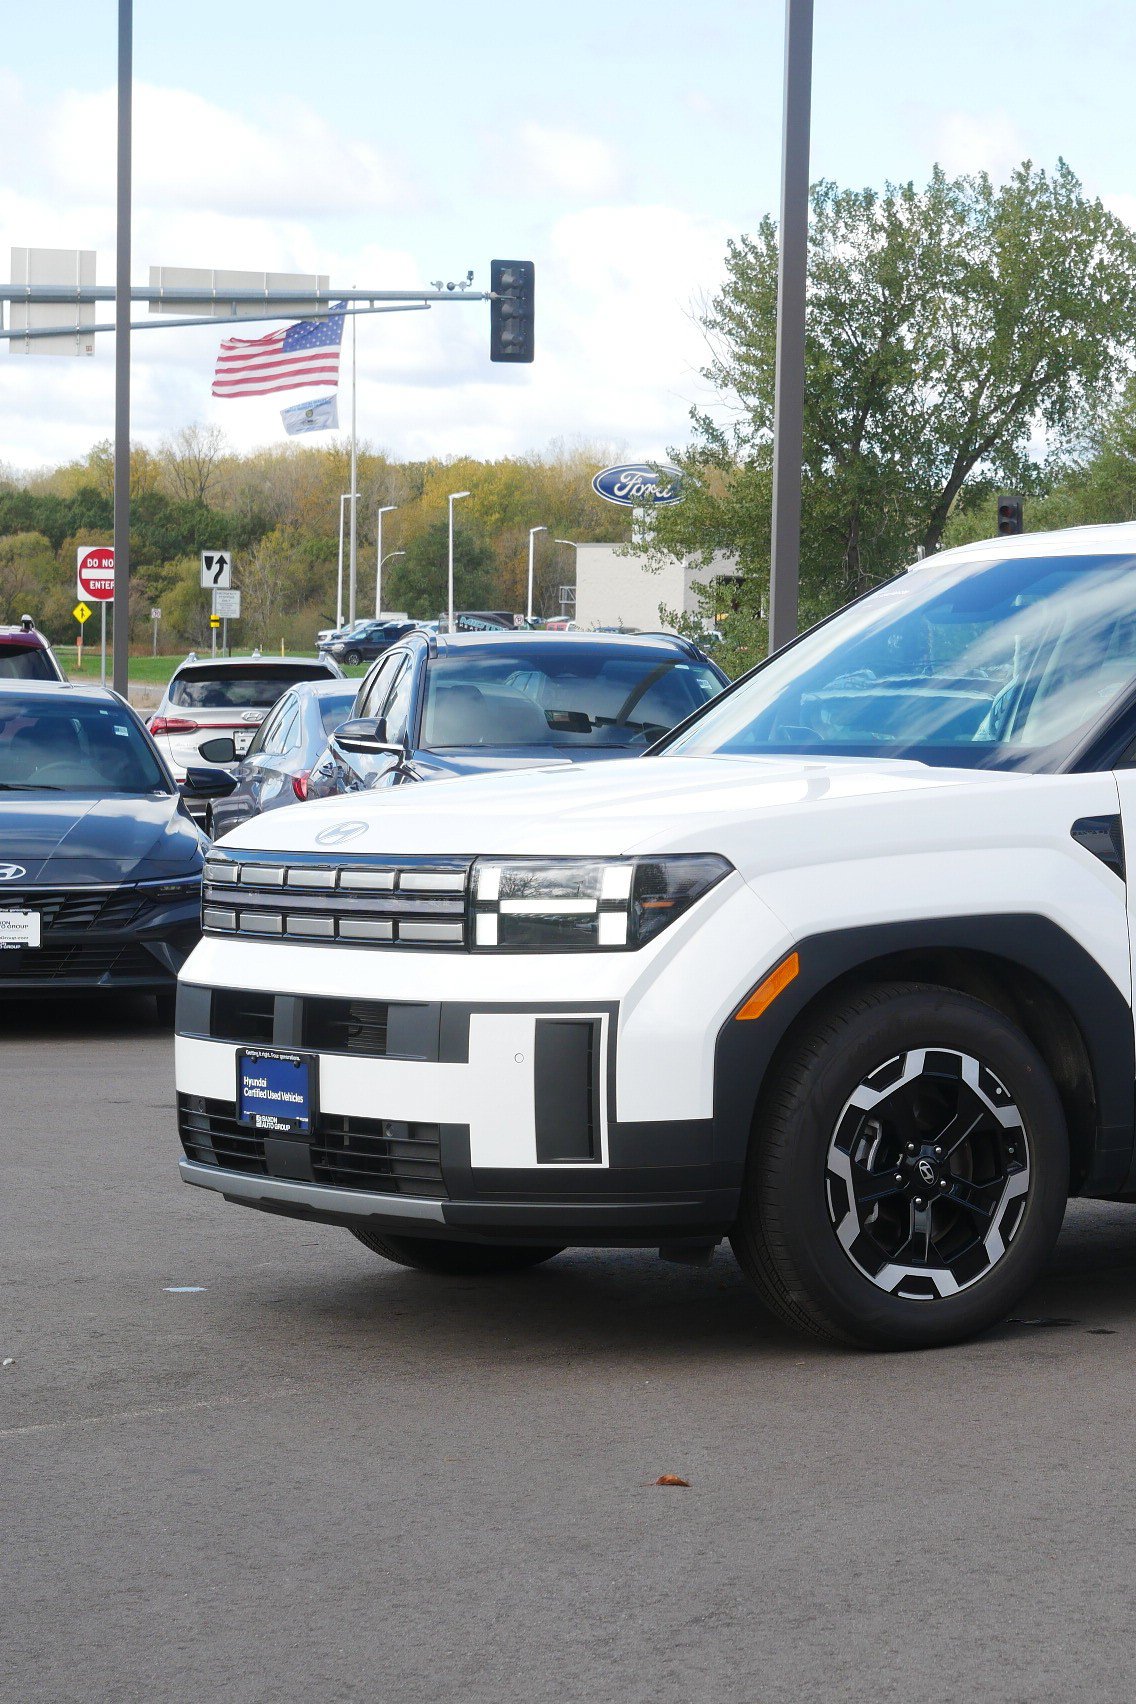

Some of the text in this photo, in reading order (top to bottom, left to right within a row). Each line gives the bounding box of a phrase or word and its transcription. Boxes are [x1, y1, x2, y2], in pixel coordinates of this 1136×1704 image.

[614, 471, 672, 498] Ford
[87, 558, 114, 567] DO NO
[243, 1076, 267, 1087] Hyundai
[243, 1088, 304, 1103] Certified Used Vehicles
[261, 1121, 291, 1131] AUTO GROUP
